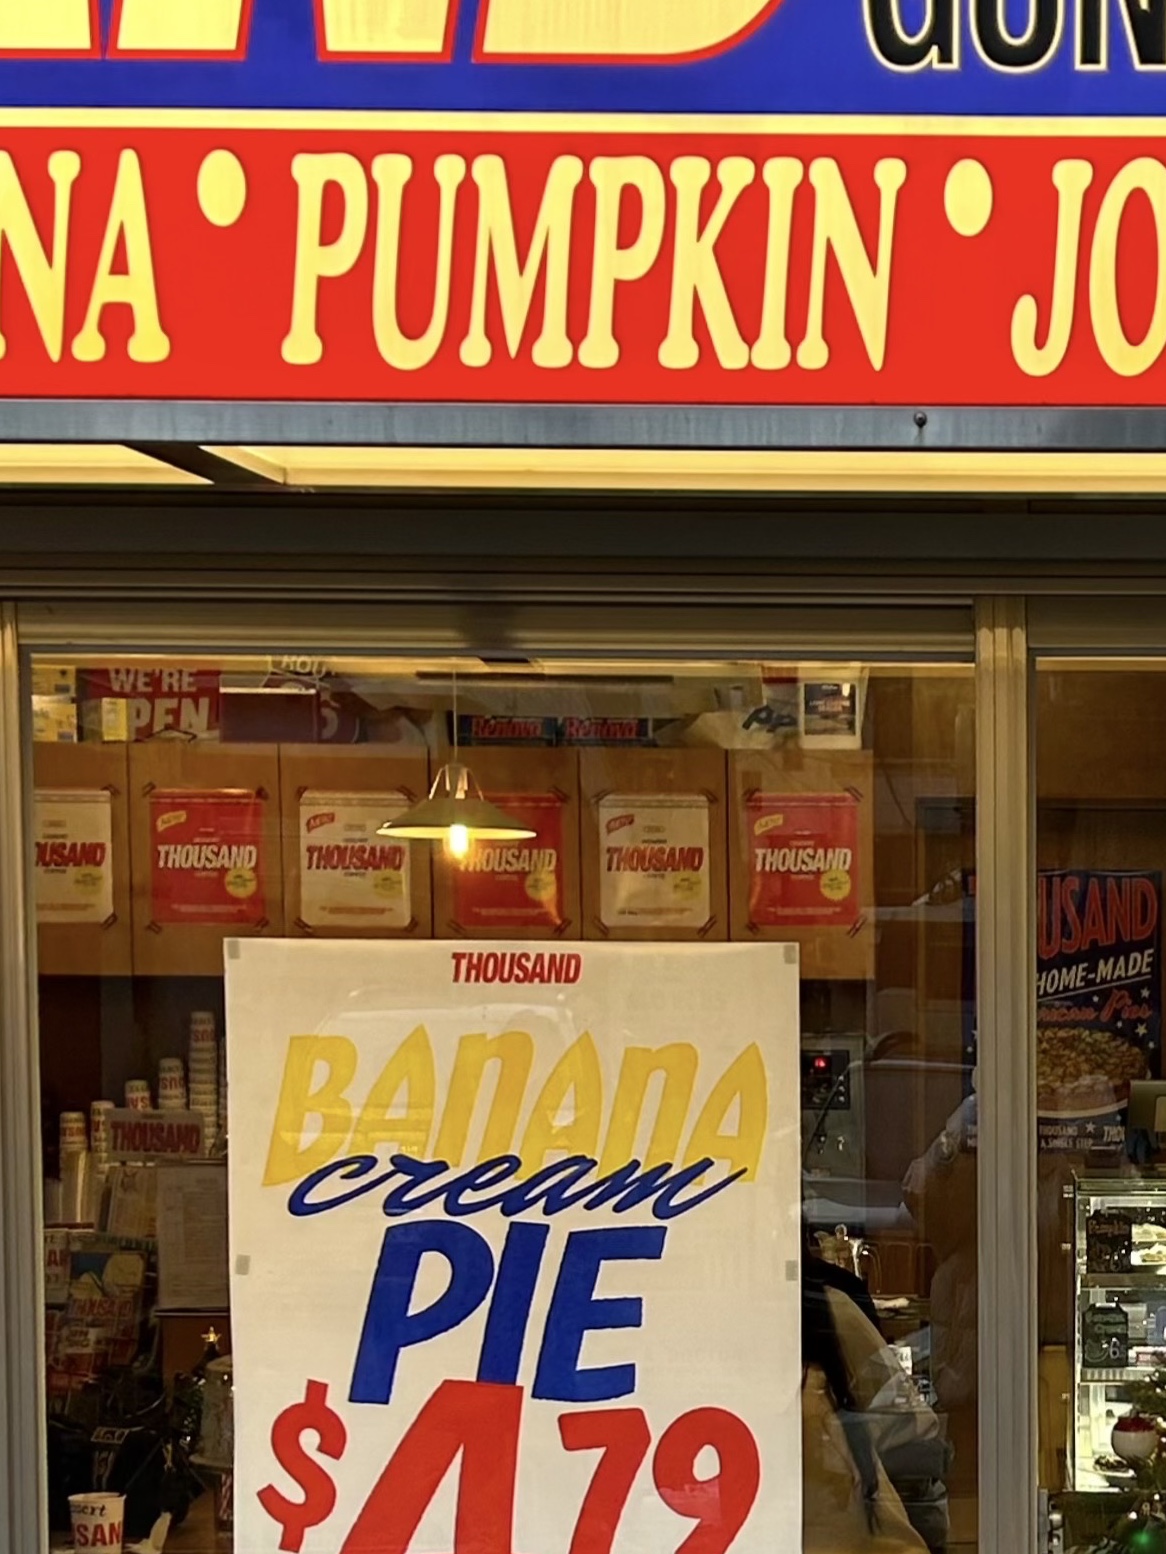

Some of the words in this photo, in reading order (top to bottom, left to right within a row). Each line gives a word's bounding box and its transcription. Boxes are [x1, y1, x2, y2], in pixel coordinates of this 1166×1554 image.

[0, 148, 171, 363] NA
[281, 152, 907, 371] PUMPKIN
[107, 668, 197, 692] WE'RE
[35, 841, 107, 868] USAND
[157, 844, 258, 869] THOUSAND
[306, 844, 407, 871] THOUSAND
[606, 845, 705, 872] THOUSAND
[754, 847, 853, 872] THOUSAND
[1038, 875, 1159, 960] USAND
[451, 952, 583, 984] THOUSAND
[110, 1120, 202, 1154] THOUSAND
[287, 1154, 748, 1218] cream
[348, 1219, 668, 1405] PIE
